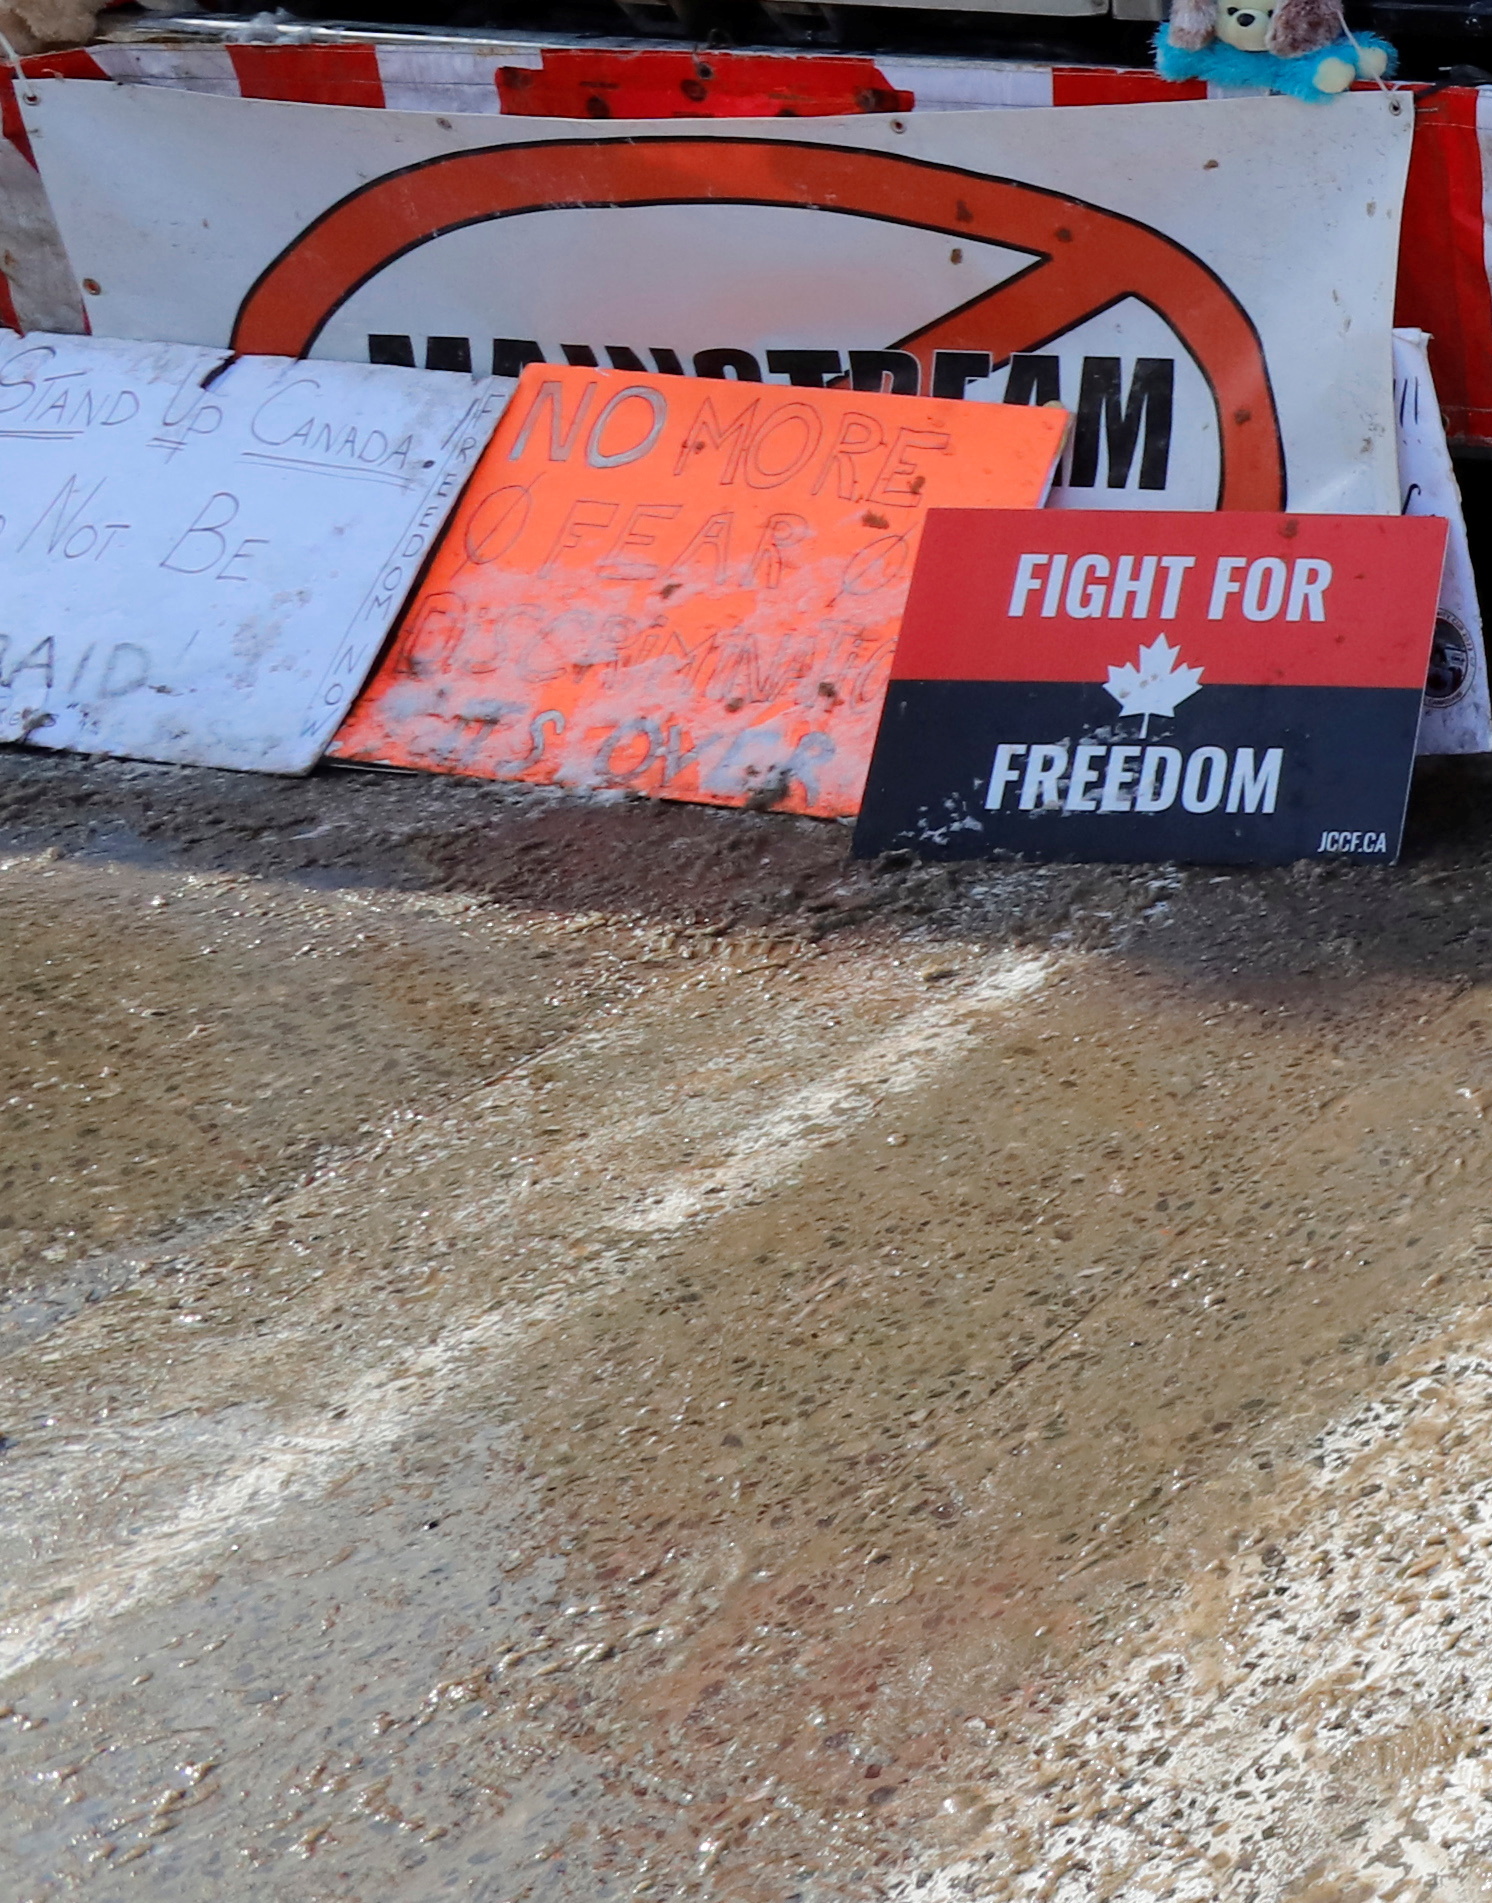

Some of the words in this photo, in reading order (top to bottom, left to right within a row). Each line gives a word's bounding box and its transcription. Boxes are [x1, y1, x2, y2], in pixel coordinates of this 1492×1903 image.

[0, 346, 140, 427] STAND
[508, 381, 667, 468] NO
[674, 398, 950, 508] MORE
[17, 475, 131, 561] NOT
[160, 492, 269, 581] BE
[538, 500, 809, 589] FEAR
[1008, 553, 1196, 620] FIGHT
[1207, 556, 1333, 623] FOR
[985, 744, 1285, 815] FREEDOM
[1317, 830, 1387, 853] JCCF.CA
